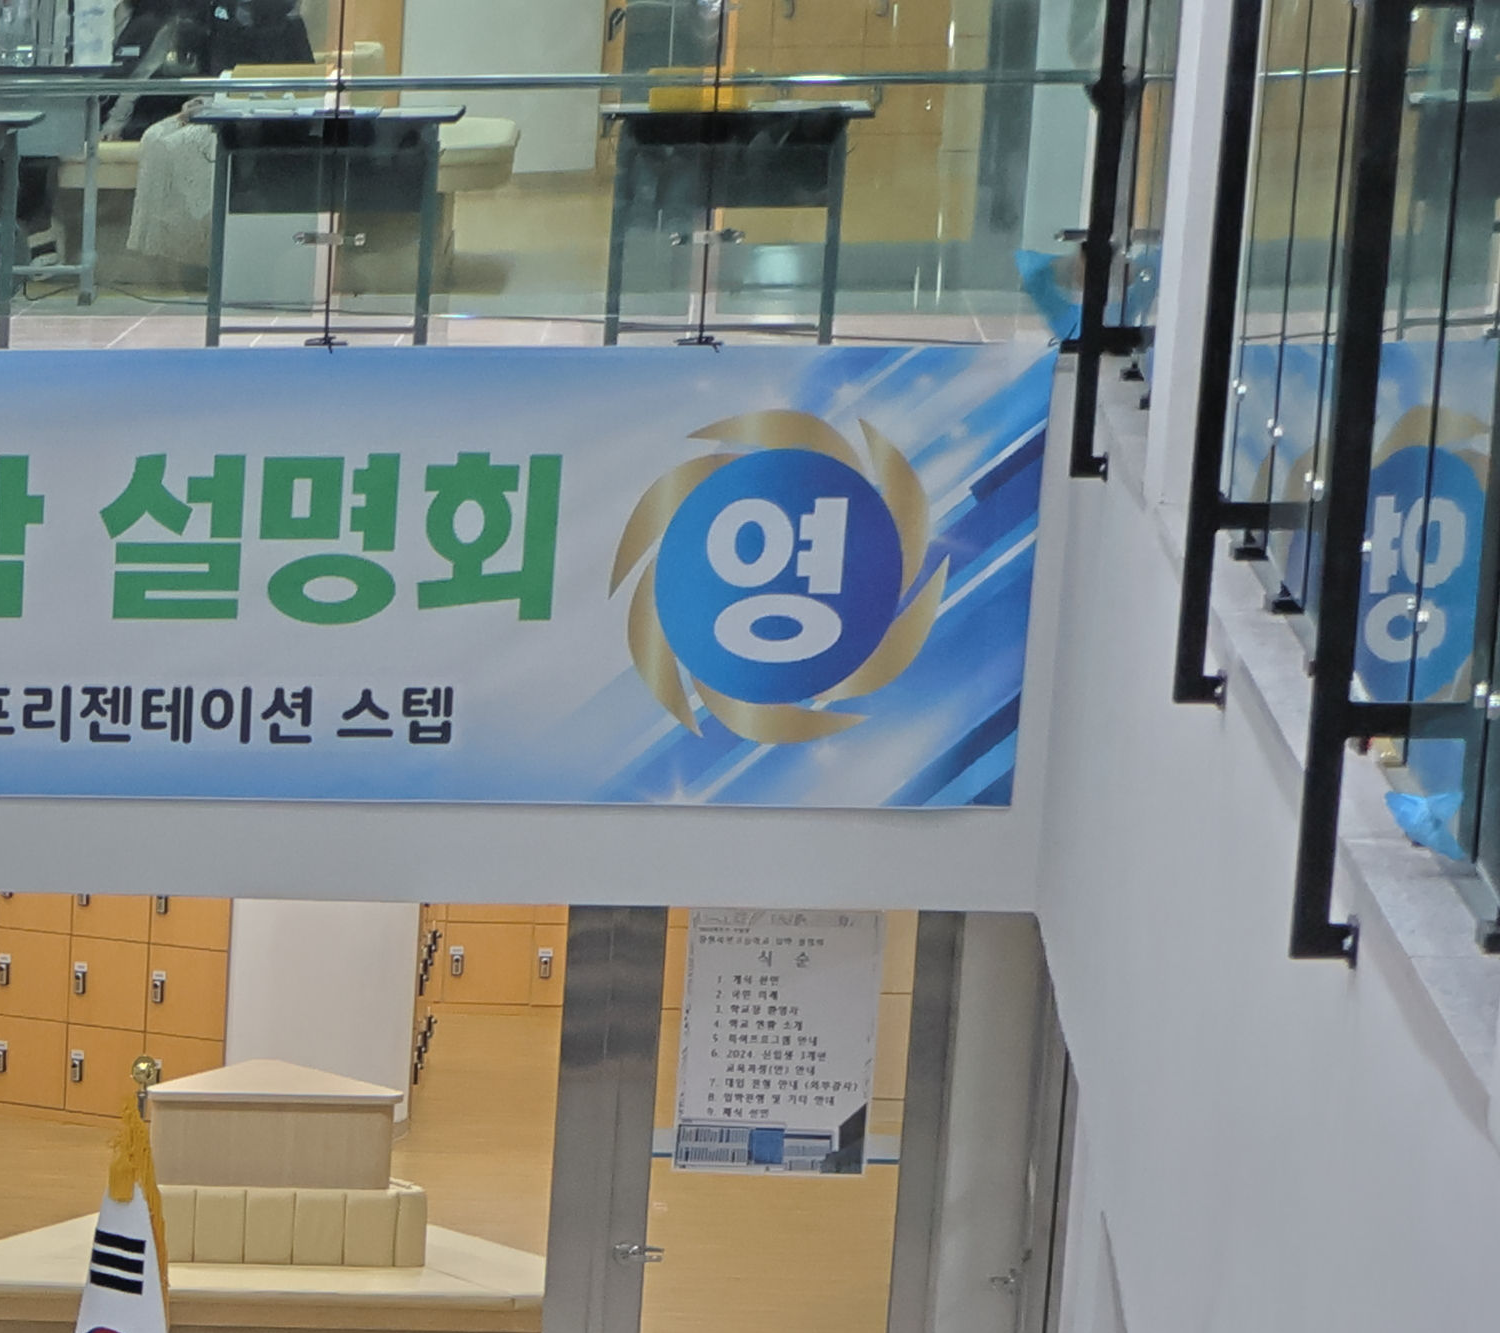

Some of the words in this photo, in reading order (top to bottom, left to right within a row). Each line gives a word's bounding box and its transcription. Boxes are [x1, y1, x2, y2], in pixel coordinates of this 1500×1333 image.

[99, 451, 564, 625] 설명회
[705, 496, 849, 663] 영
[336, 685, 456, 744] 스텝
